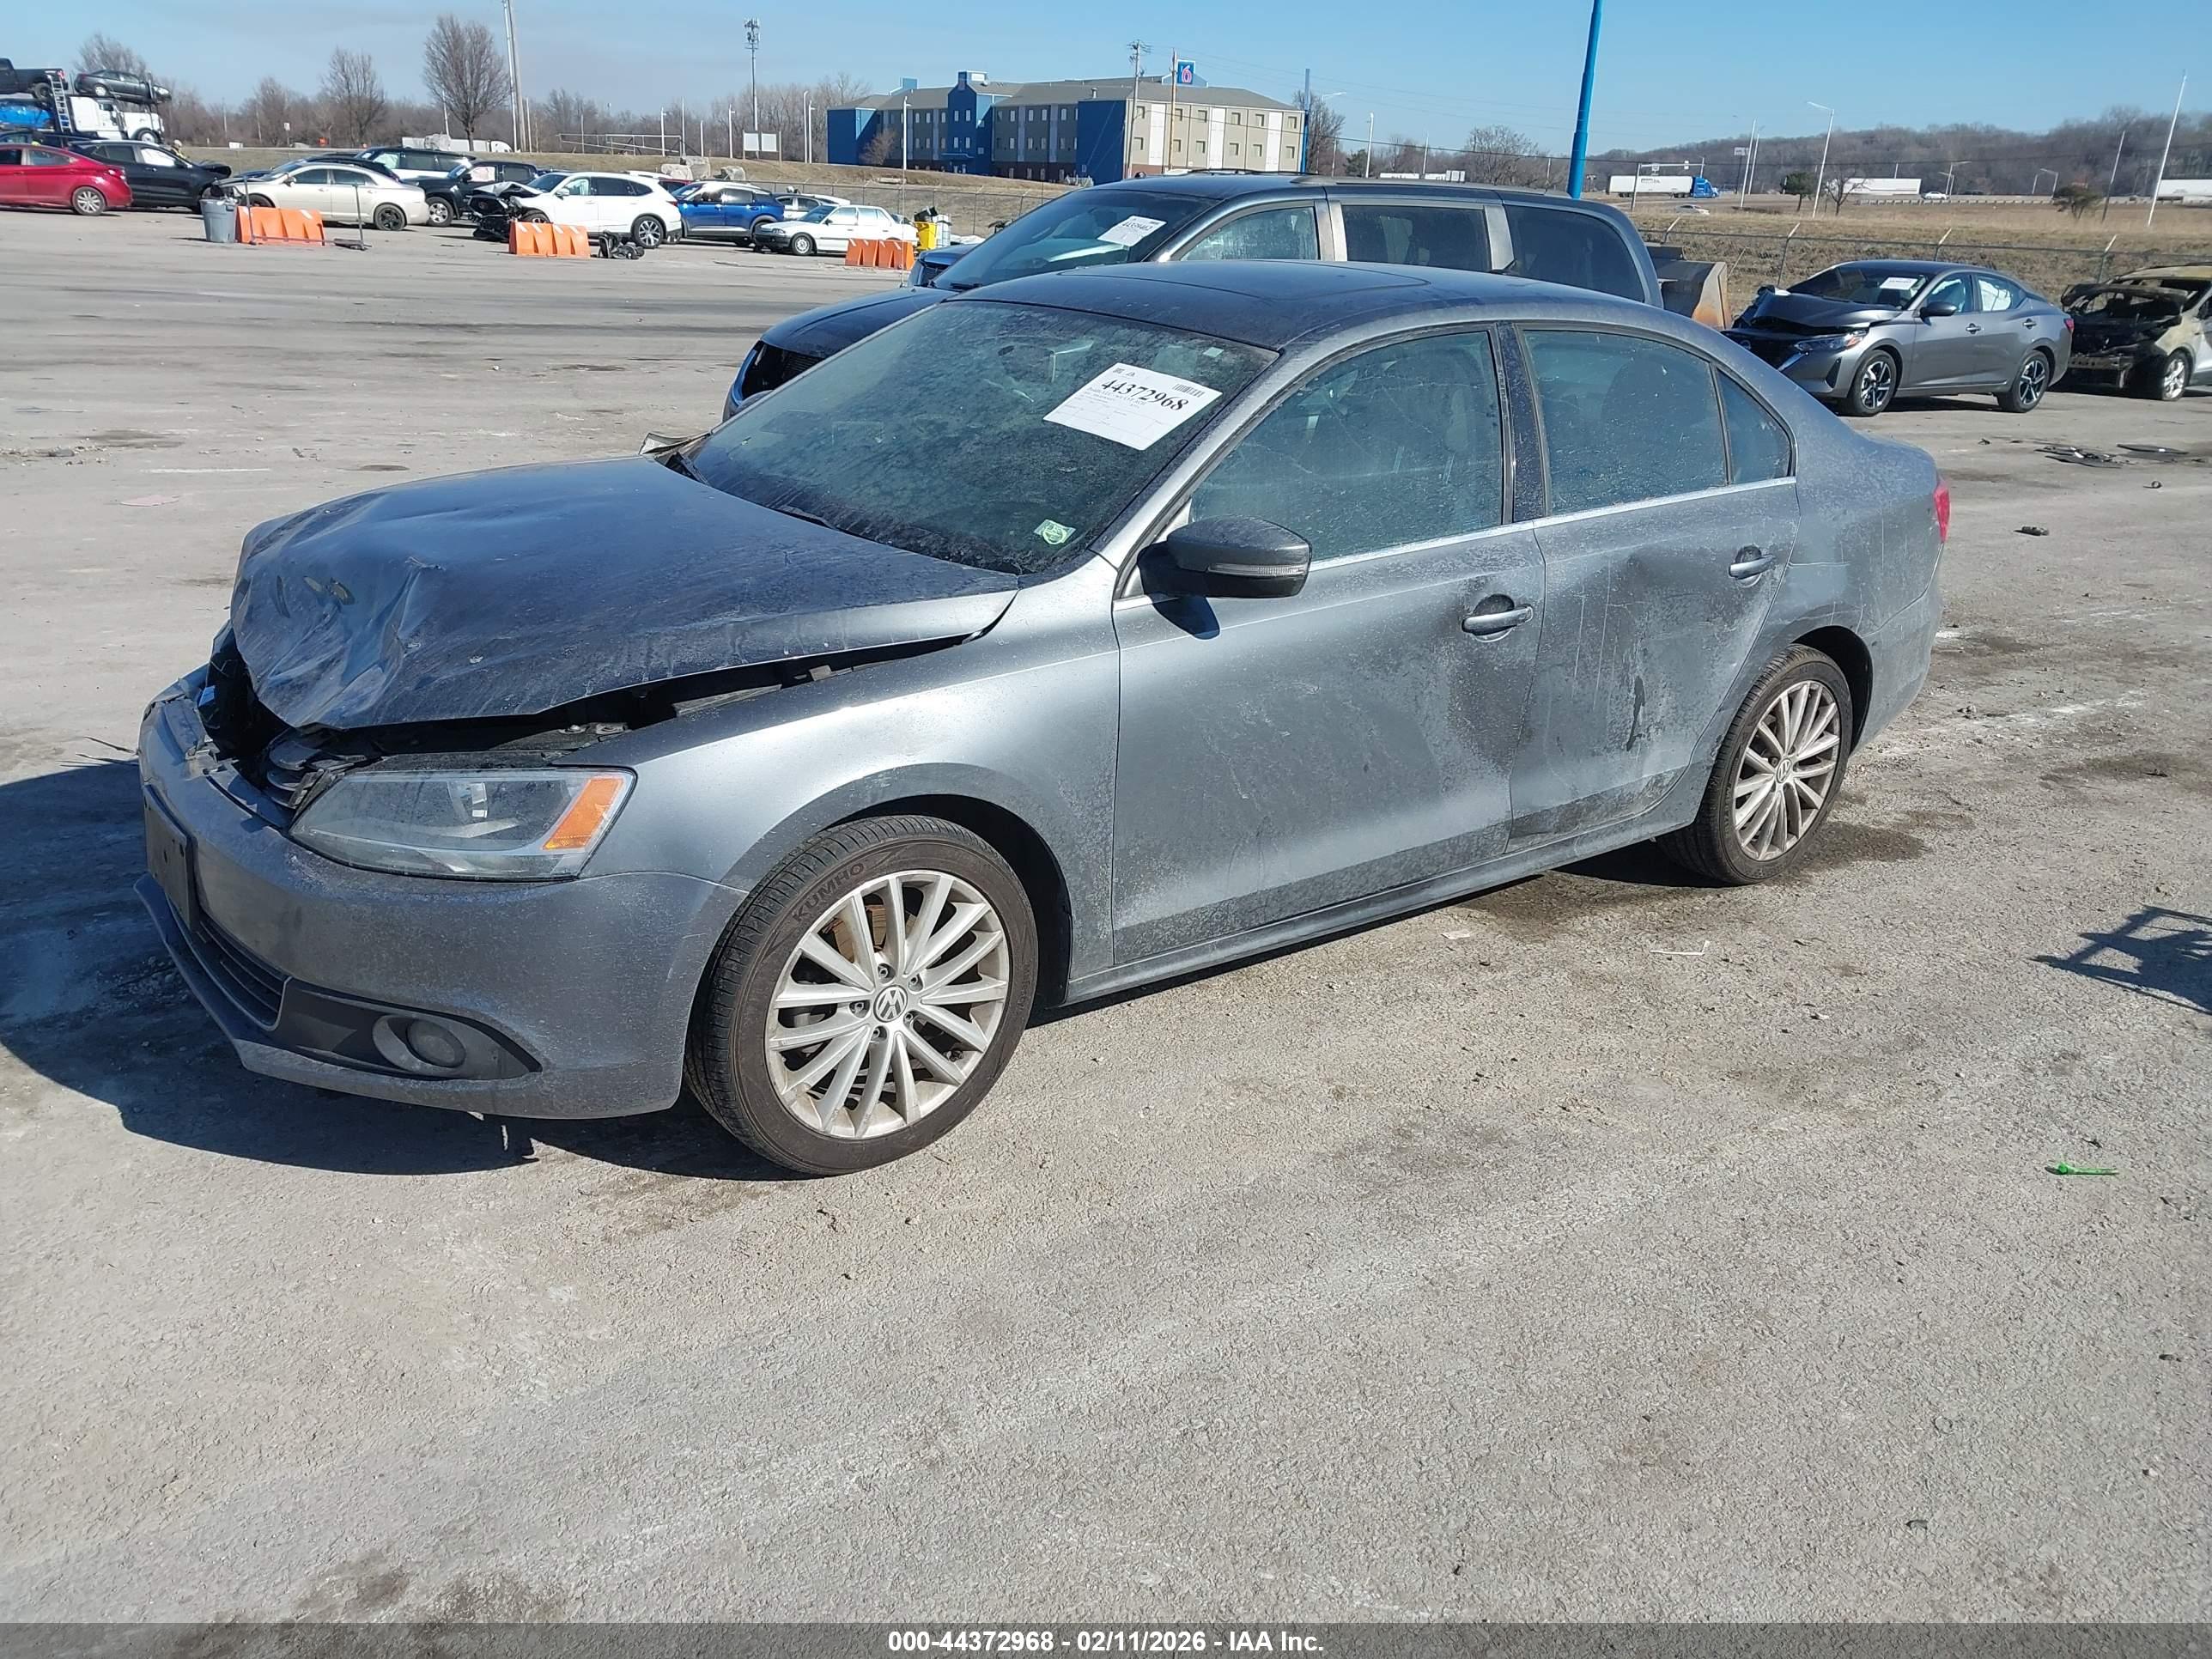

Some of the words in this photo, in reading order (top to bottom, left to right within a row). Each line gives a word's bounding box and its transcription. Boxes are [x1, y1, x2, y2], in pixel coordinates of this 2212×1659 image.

[1182, 64, 1192, 83] 6
[1101, 379, 1189, 411] 44372968
[792, 863, 865, 923] KUMHO
